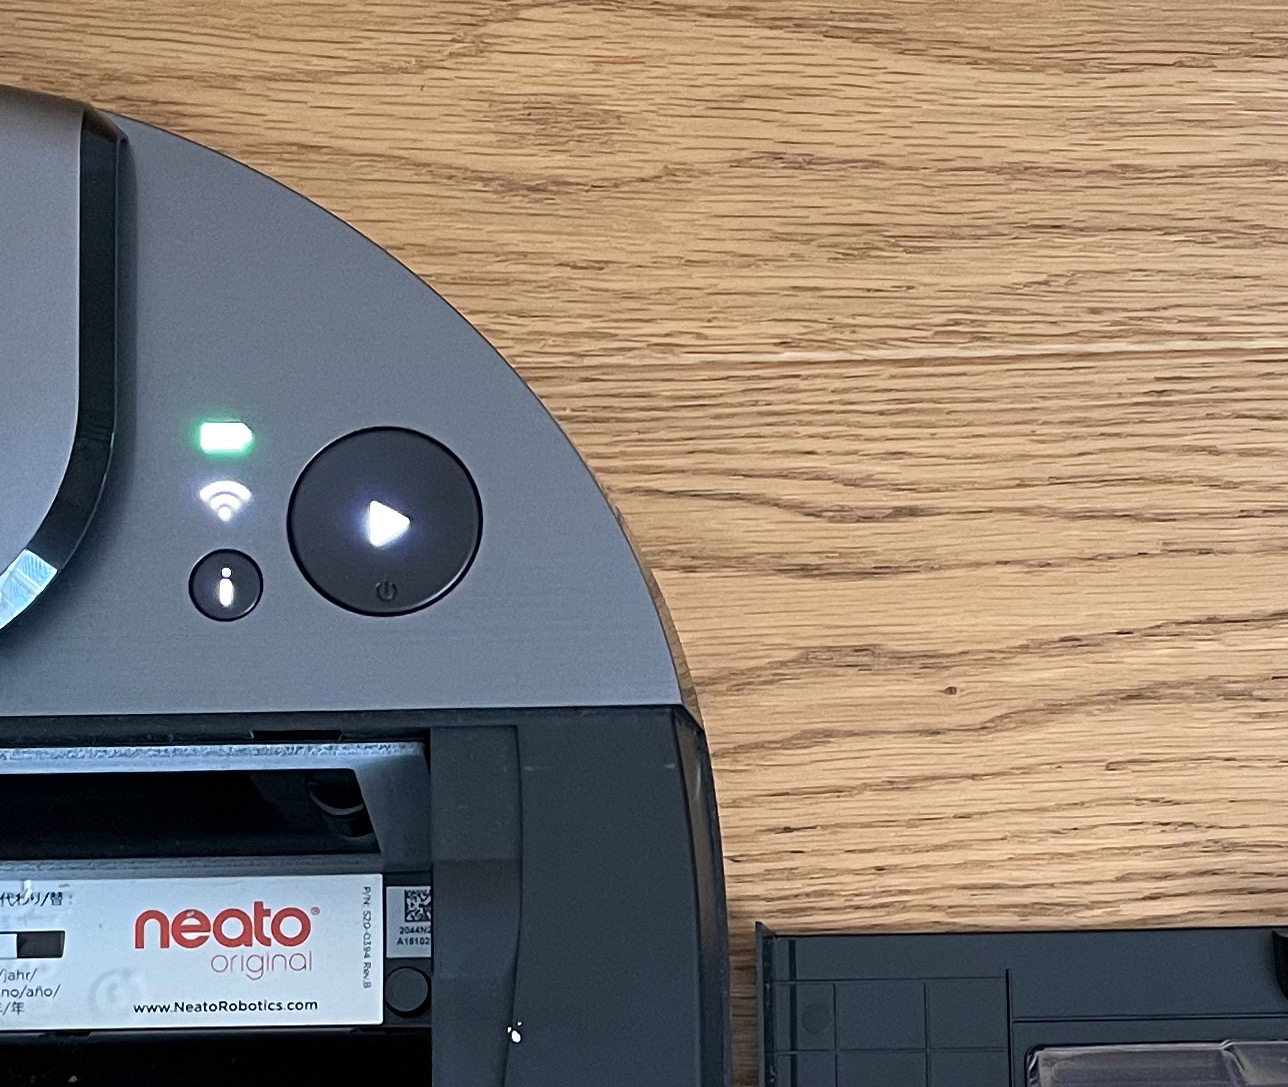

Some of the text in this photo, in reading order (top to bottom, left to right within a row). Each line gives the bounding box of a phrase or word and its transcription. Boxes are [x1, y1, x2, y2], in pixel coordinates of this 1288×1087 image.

[134, 900, 312, 950] neato
[362, 909, 371, 958] 520-0394
[211, 951, 313, 981] original
[132, 999, 319, 1014] www.NeatoRobotics.com
